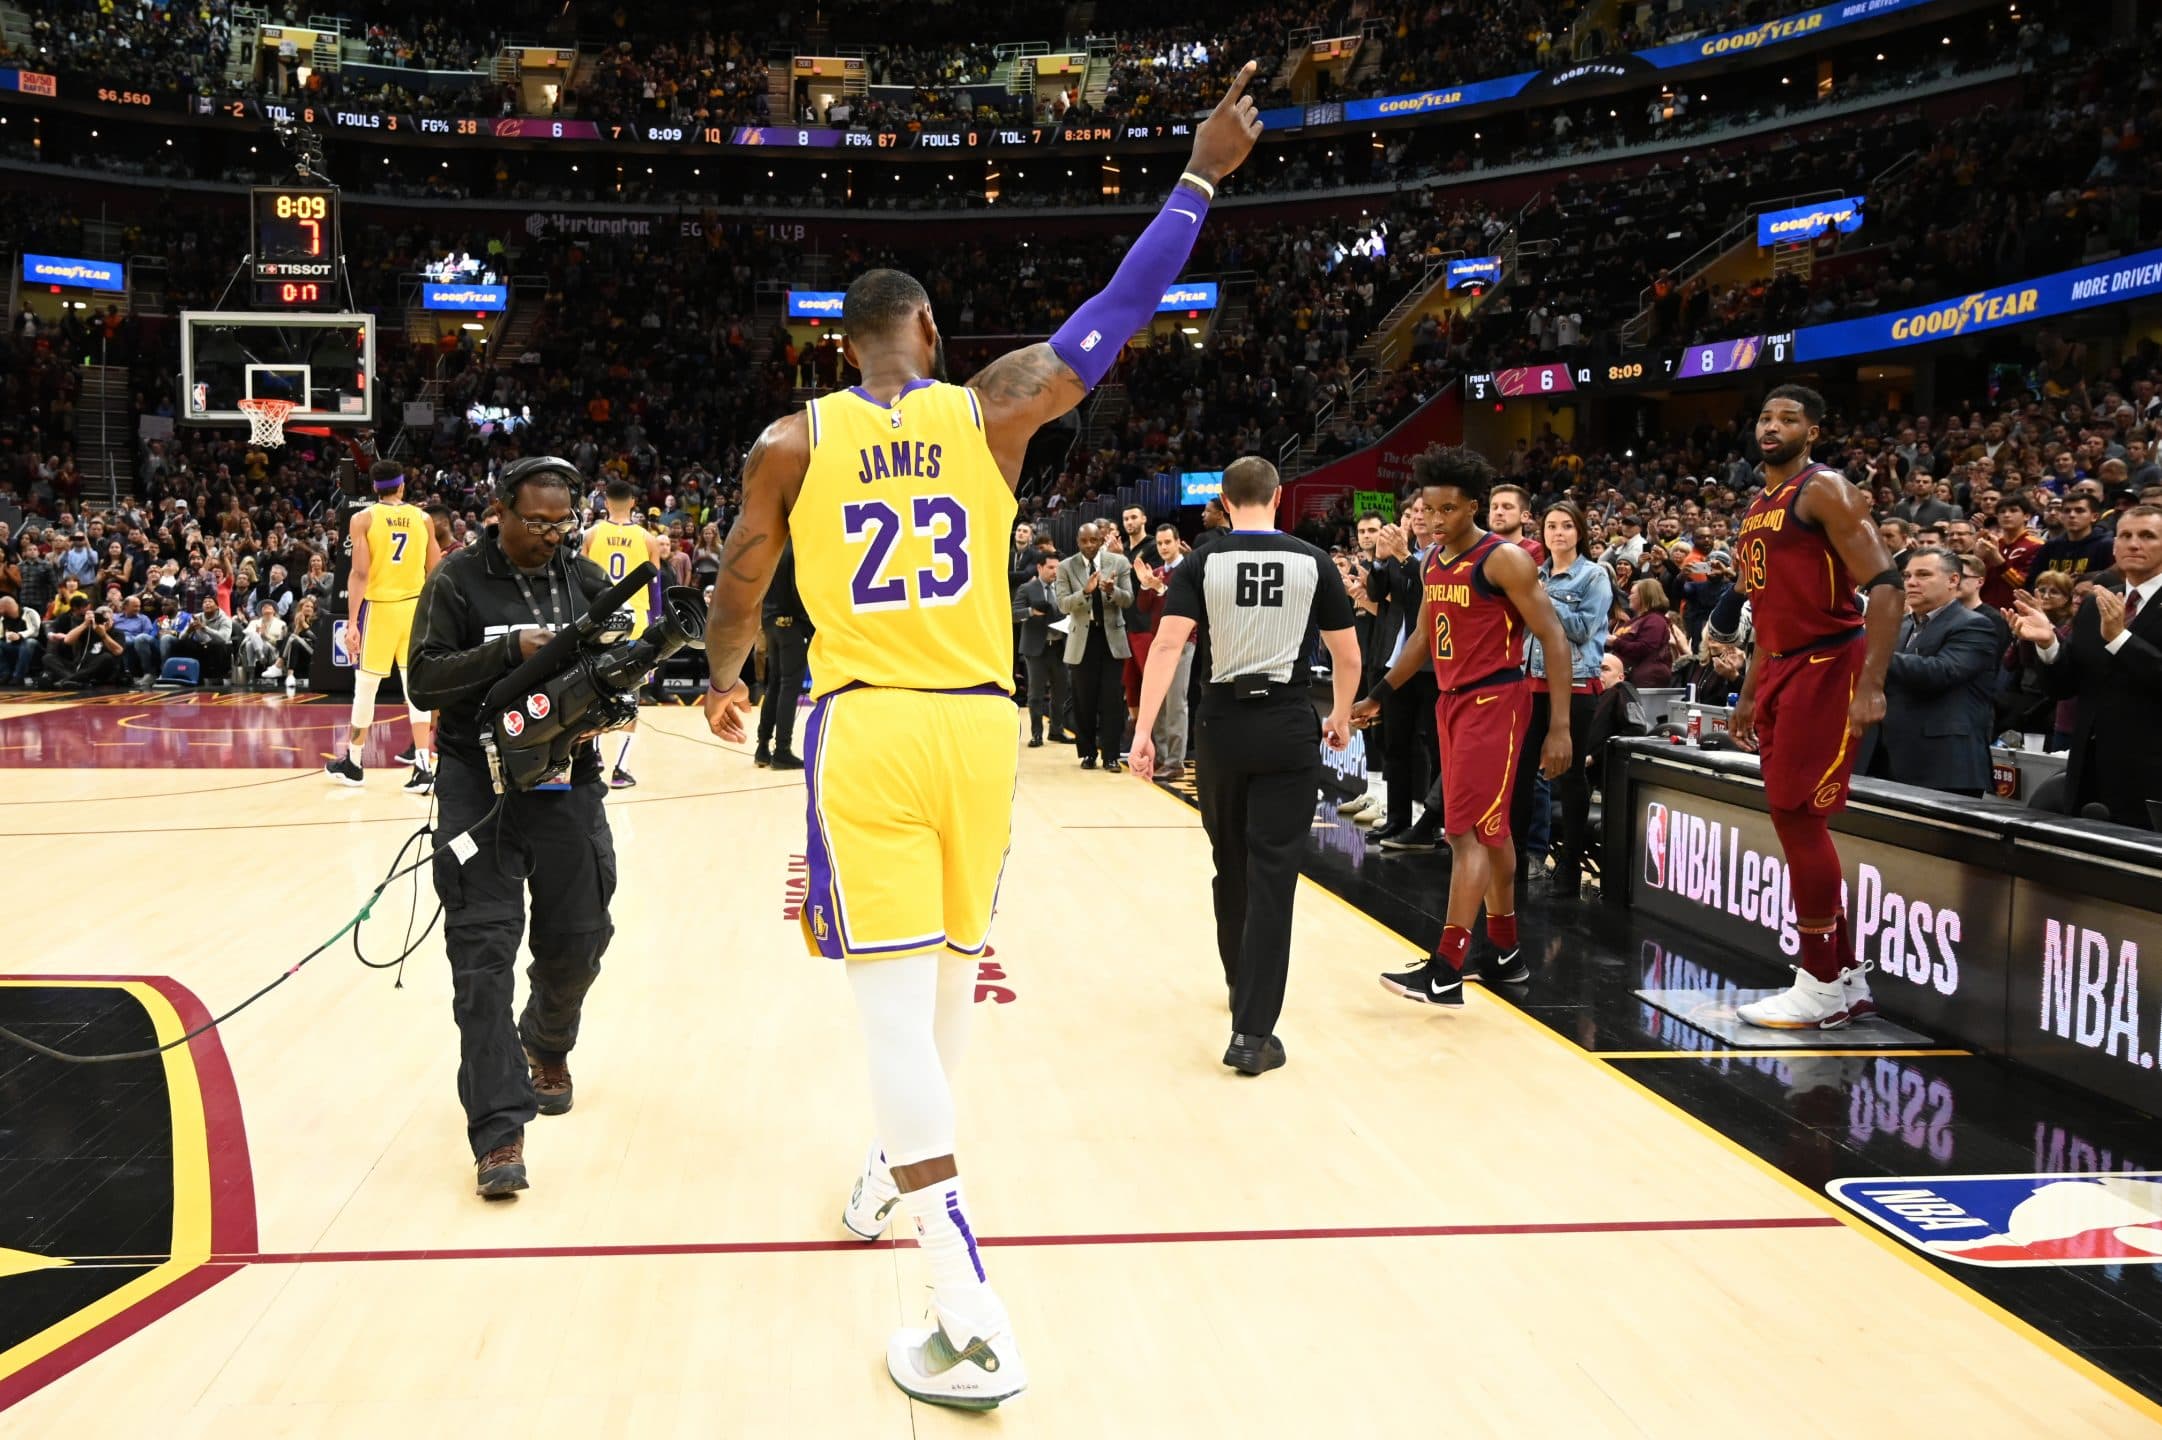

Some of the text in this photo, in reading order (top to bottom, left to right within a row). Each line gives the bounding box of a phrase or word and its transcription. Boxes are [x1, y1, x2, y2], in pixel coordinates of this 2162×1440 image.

[1842, 2, 1867, 17] MORE
[1702, 14, 1822, 55] GOODYEAR
[1553, 65, 1625, 86] GOODYEAR
[98, 89, 151, 105] $6,560
[1379, 92, 1461, 112] GOODYEAR
[224, 102, 245, 117] -2
[304, 109, 315, 123] 6
[338, 113, 397, 130] FOULS 3
[421, 119, 477, 134] FG% 38
[552, 122, 563, 137] 6
[611, 127, 622, 139] 7
[648, 128, 682, 141] 8:09
[798, 131, 809, 146] 8
[1000, 130, 1042, 144] TOL: 7
[1065, 129, 1111, 141] 8:26 PM
[1128, 125, 1190, 138] POR 7 MIL
[846, 133, 896, 147] FG% 67
[922, 134, 977, 147] FOULS 0
[277, 195, 325, 219] 8:09
[300, 220, 319, 254] 7
[35, 264, 110, 281] GOODYEAR
[278, 264, 331, 275] TISSOT
[2072, 262, 2162, 301] MORE DRIVEN
[433, 291, 496, 304] GOODYEAR
[798, 299, 843, 311] GOODY
[1891, 289, 2038, 340] GOODYEAR
[1768, 333, 1791, 345] FOULS
[1701, 350, 1714, 372] 8
[1775, 344, 1784, 362] 0
[1608, 364, 1643, 380] 8:09
[1665, 360, 1672, 372] 7
[1469, 374, 1490, 384] FOULS
[1541, 370, 1553, 390] 6
[1475, 384, 1485, 399] 3
[859, 441, 942, 484] JAMES
[391, 531, 408, 564] 7
[842, 496, 970, 612] 23
[609, 552, 626, 580] 0
[1741, 538, 1767, 593] 13
[1236, 562, 1284, 607] 62
[1435, 612, 1453, 660] 2
[1669, 810, 1722, 909] NBA
[1727, 826, 1848, 957] Leag
[1856, 862, 1961, 996] Pass
[1861, 1188, 1989, 1231] NBA
